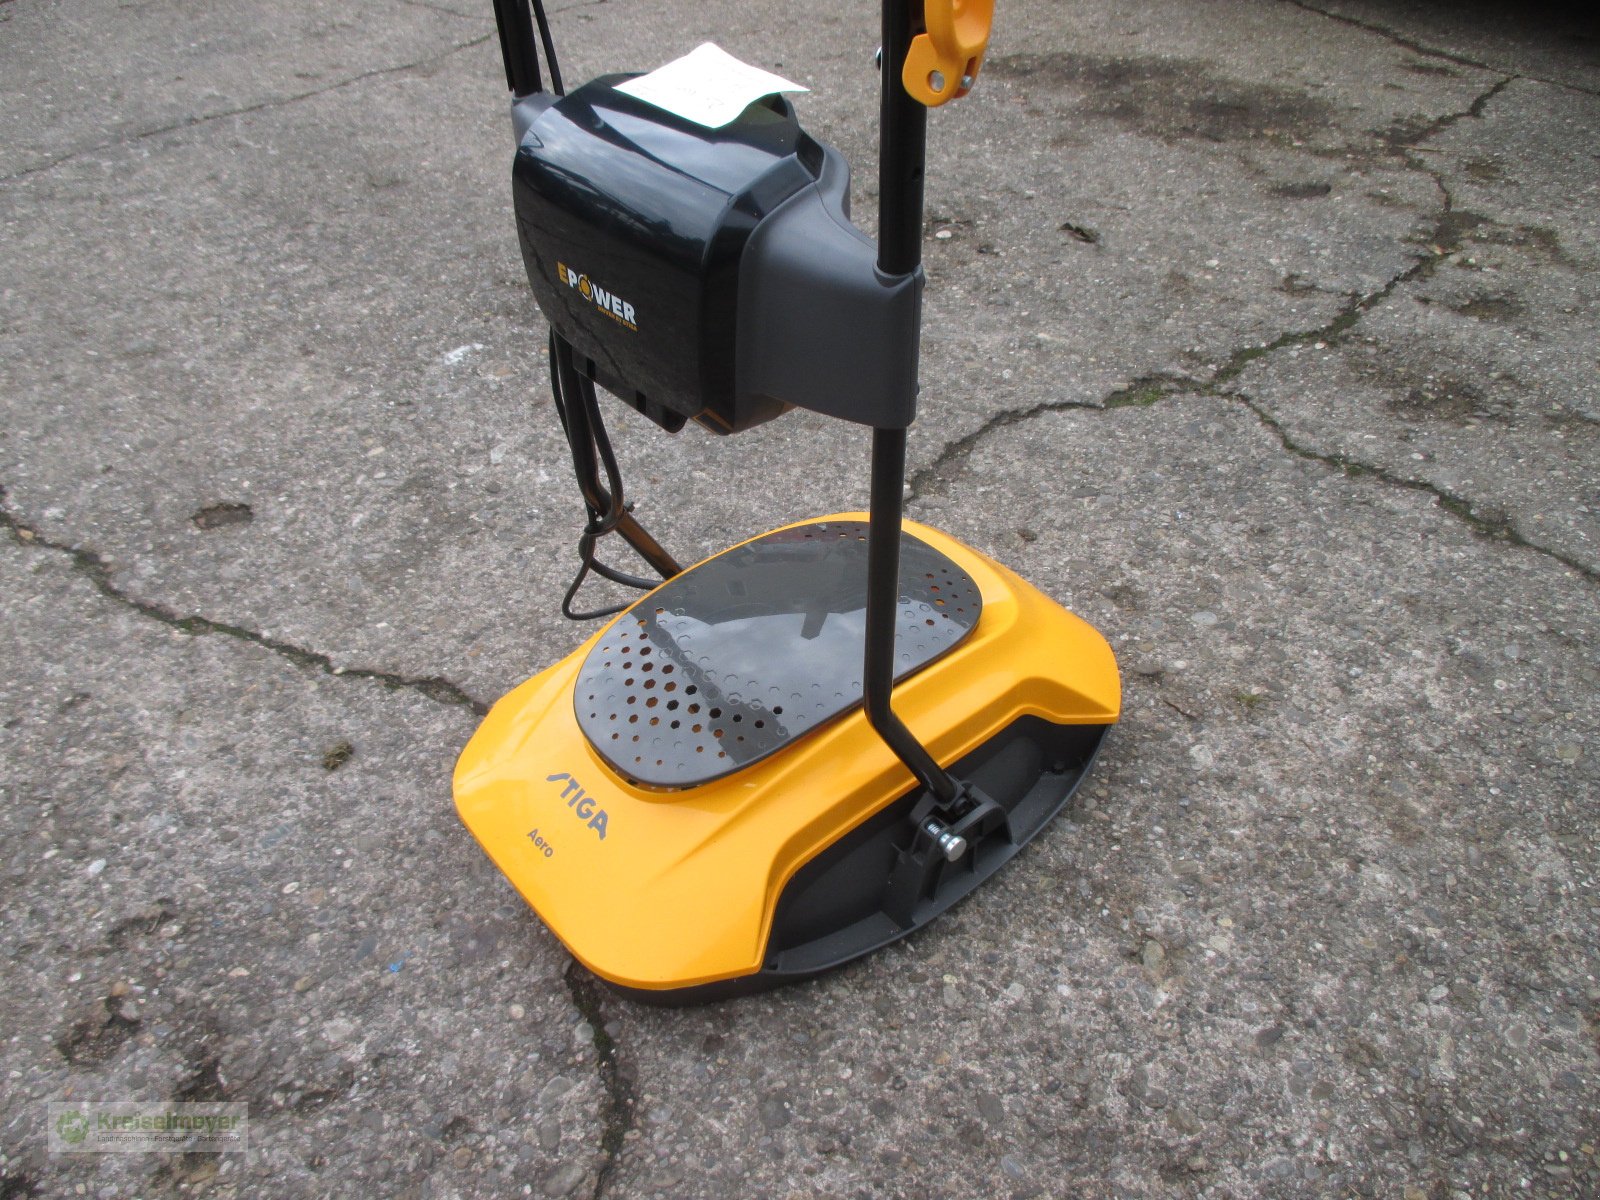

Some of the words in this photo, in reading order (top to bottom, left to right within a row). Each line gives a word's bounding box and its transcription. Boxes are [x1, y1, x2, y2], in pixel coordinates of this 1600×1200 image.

[557, 261, 637, 326] EPOWER
[546, 773, 609, 841] STIGA
[527, 828, 554, 858] Aero
